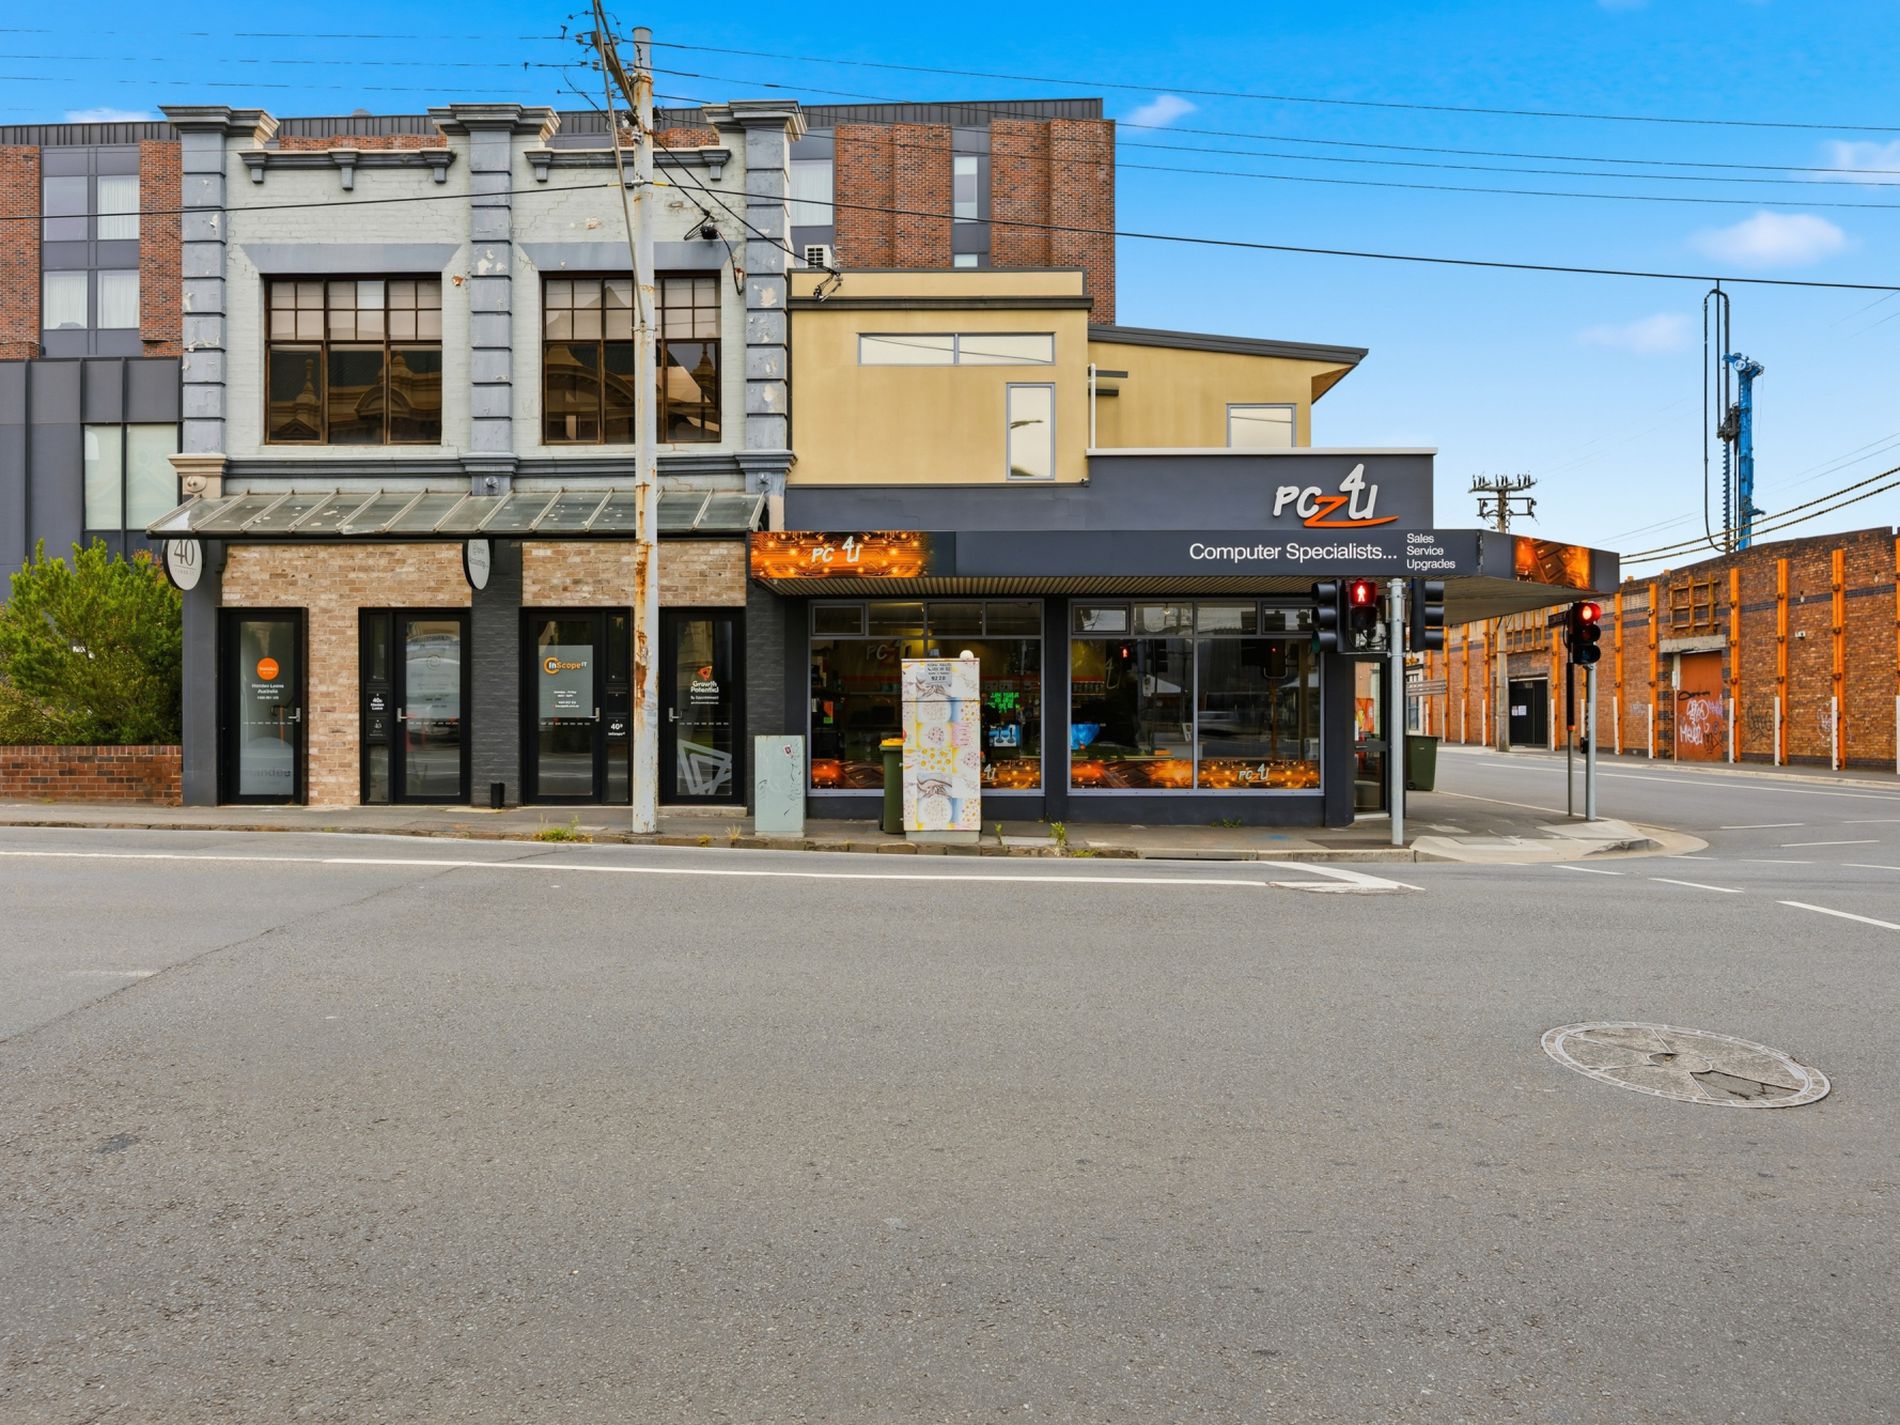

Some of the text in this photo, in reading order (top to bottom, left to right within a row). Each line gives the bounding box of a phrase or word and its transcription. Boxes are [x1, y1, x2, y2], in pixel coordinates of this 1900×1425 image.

[1406, 532, 1434, 544] Sales
[174, 539, 195, 567] 40
[1189, 543, 1282, 563] Computer
[1406, 545, 1444, 556] Service
[1406, 559, 1456, 571] Upgrades
